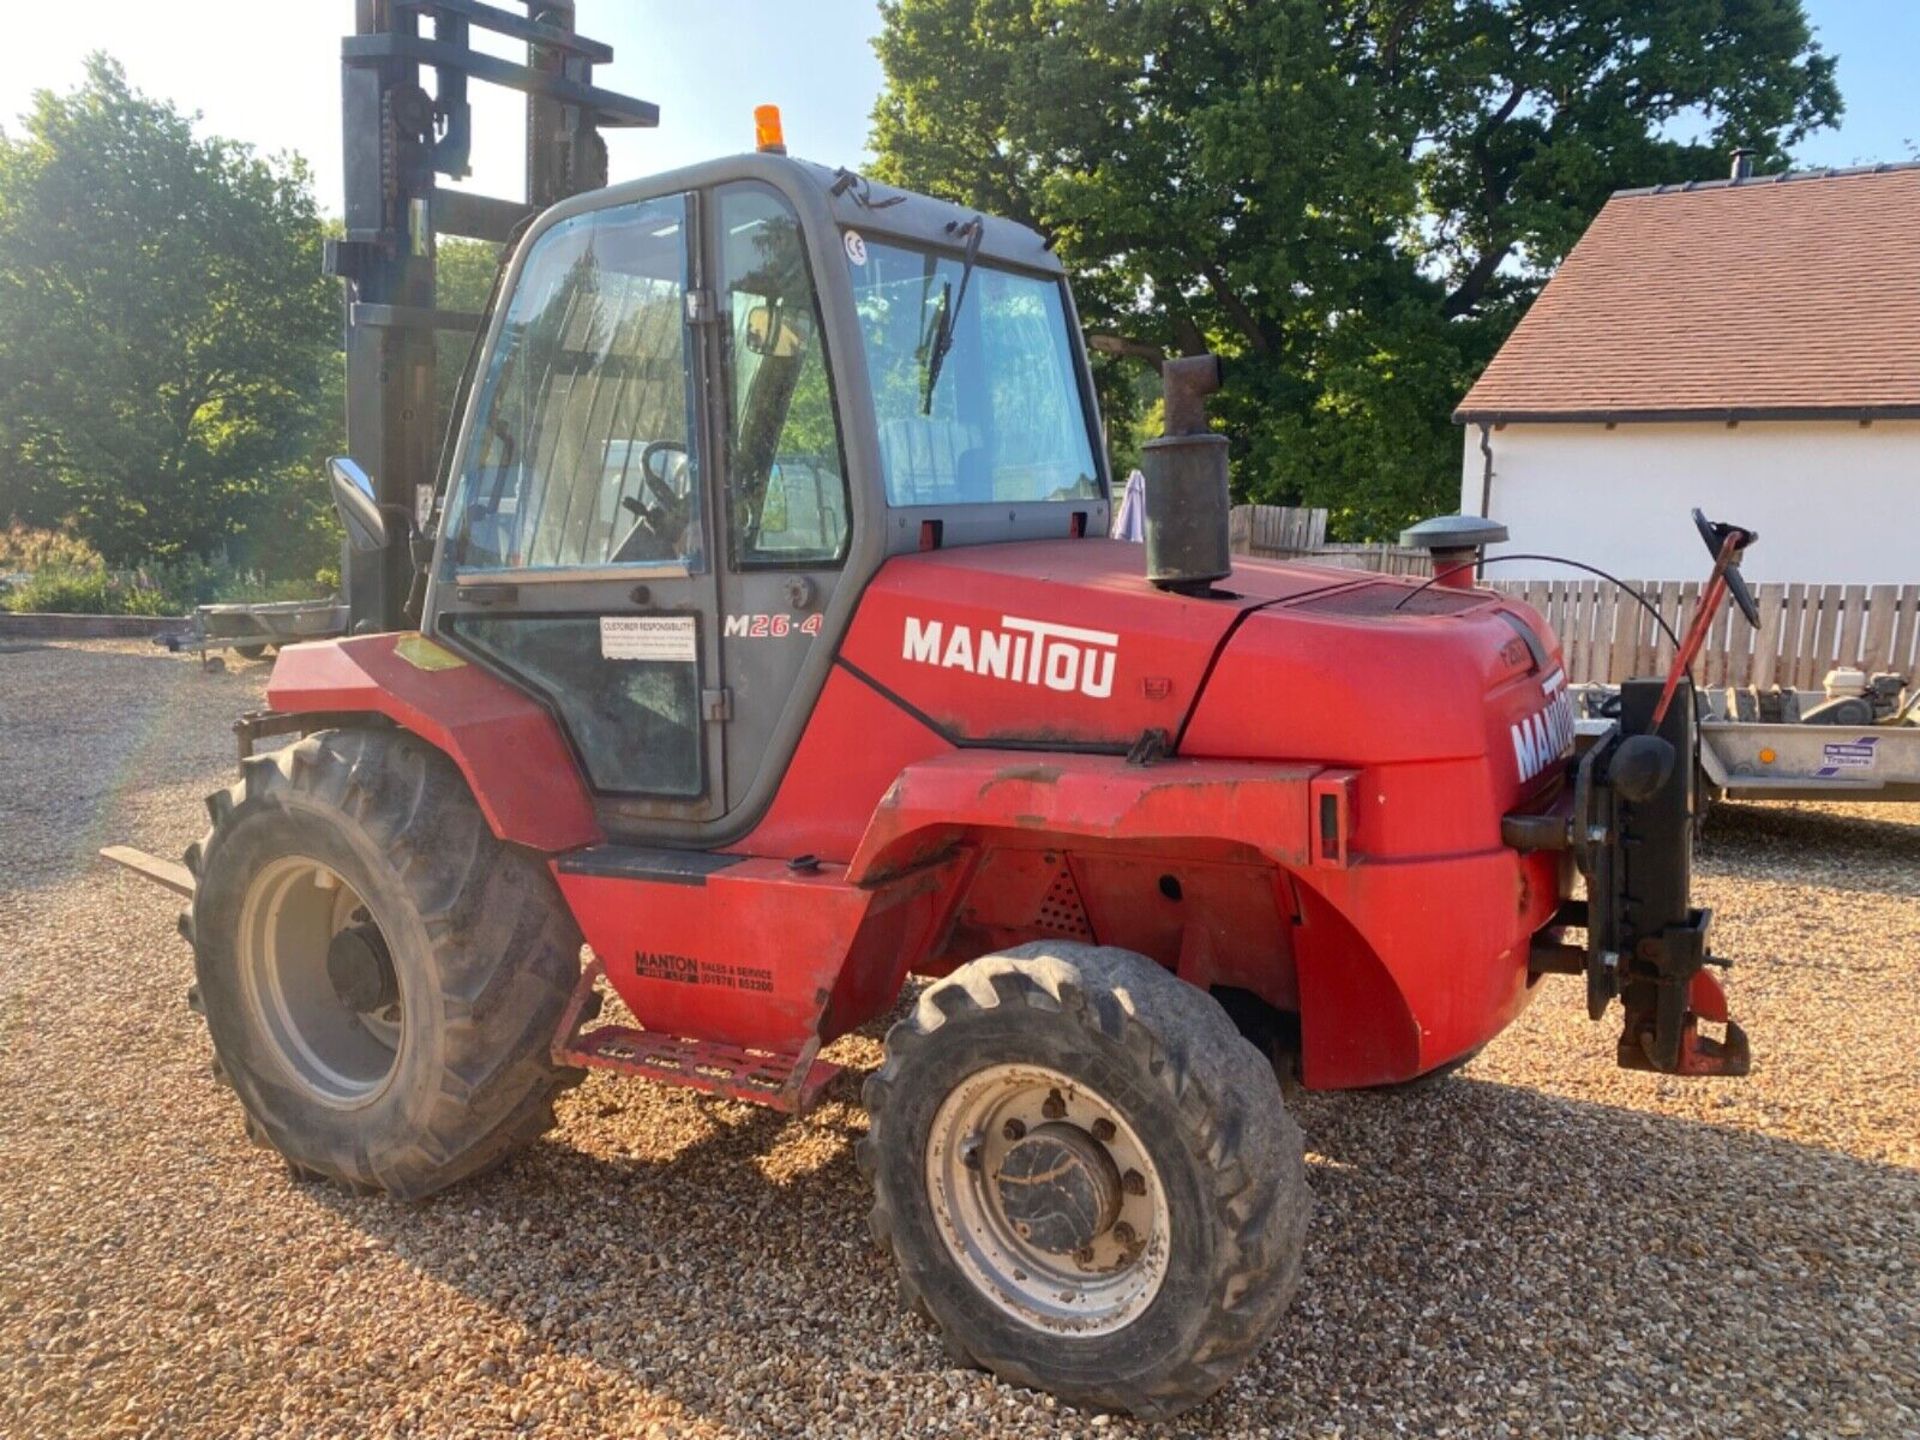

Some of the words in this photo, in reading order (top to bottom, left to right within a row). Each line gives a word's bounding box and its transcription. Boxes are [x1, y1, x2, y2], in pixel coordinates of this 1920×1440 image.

[639, 622, 692, 632] RESPONSIBILITY
[723, 614, 824, 637] M26-4
[902, 615, 1119, 698] MANITOU
[635, 950, 698, 974] MANTON
